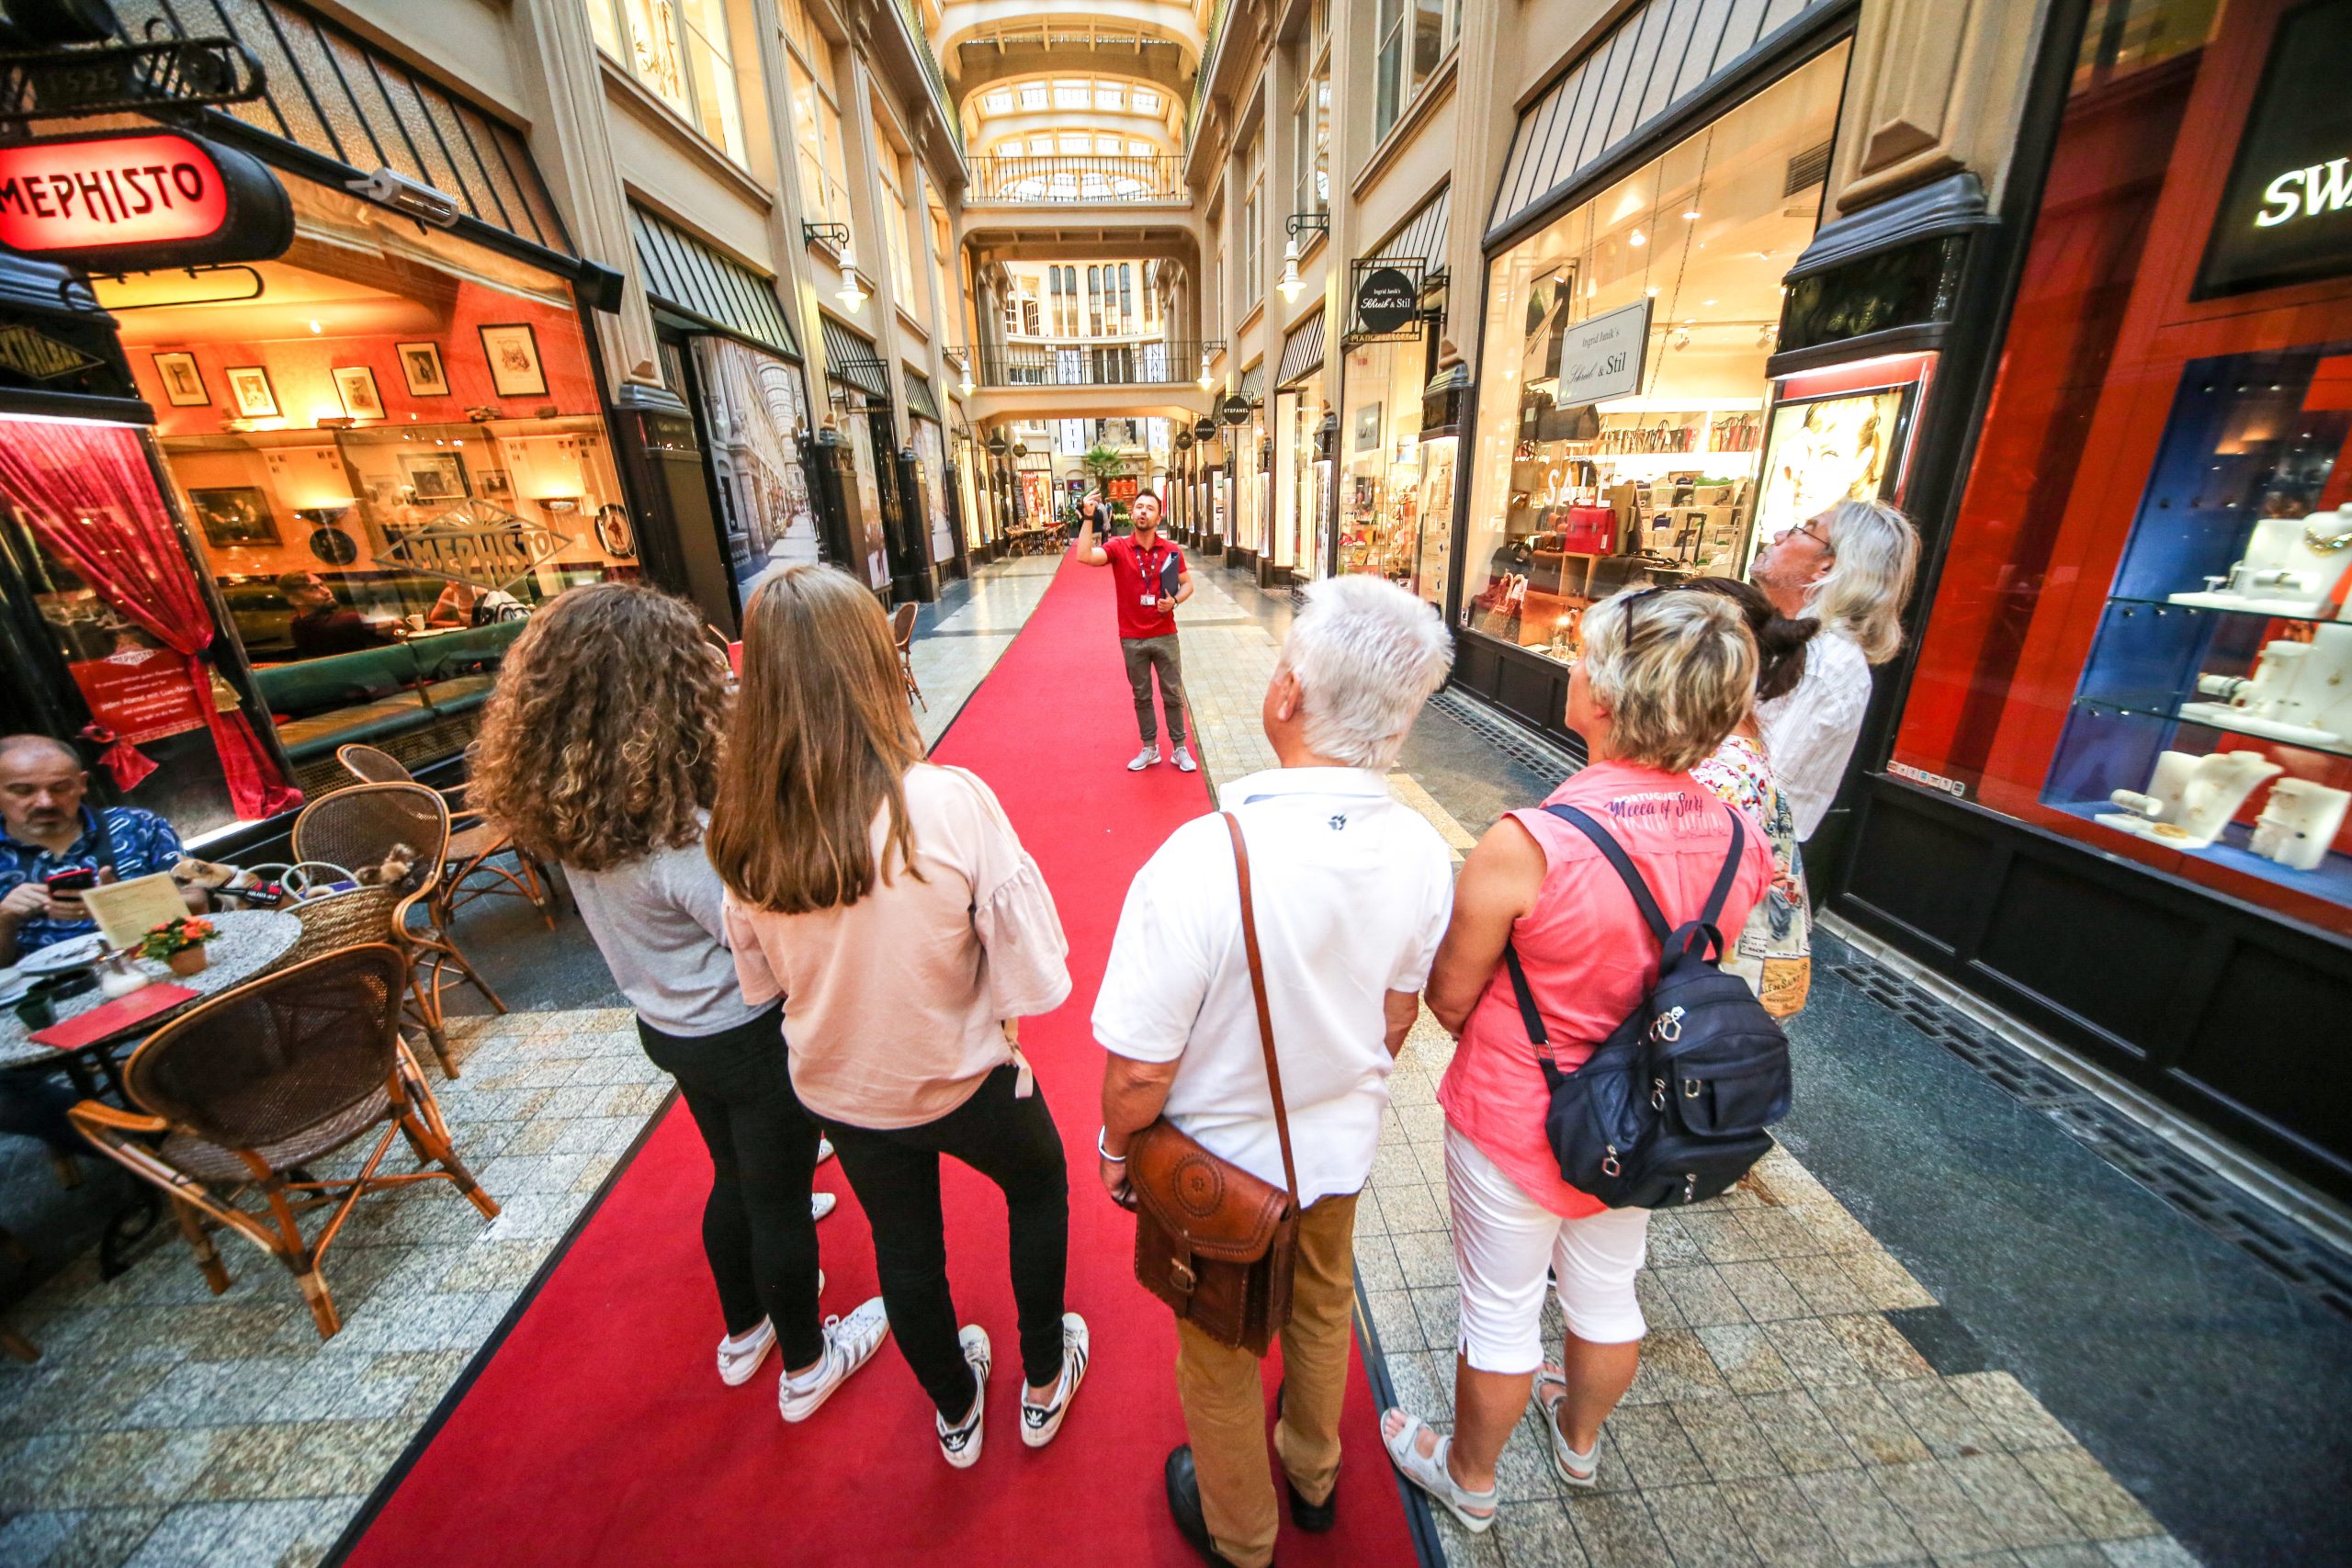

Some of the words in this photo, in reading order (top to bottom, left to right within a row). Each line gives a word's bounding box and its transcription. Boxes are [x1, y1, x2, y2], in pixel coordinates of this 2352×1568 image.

[0, 163, 204, 224] MEPHISTO
[2254, 156, 2352, 227] SW
[1396, 298, 1410, 308] Stil
[1582, 332, 1599, 348] Ingrid
[1598, 366, 1604, 377] &
[1606, 351, 1626, 375] Stil
[1544, 466, 1615, 508] SALE
[410, 530, 551, 587] MEPHISTO
[1603, 799, 1656, 818] Mecca
[1676, 793, 1703, 818] Surf
